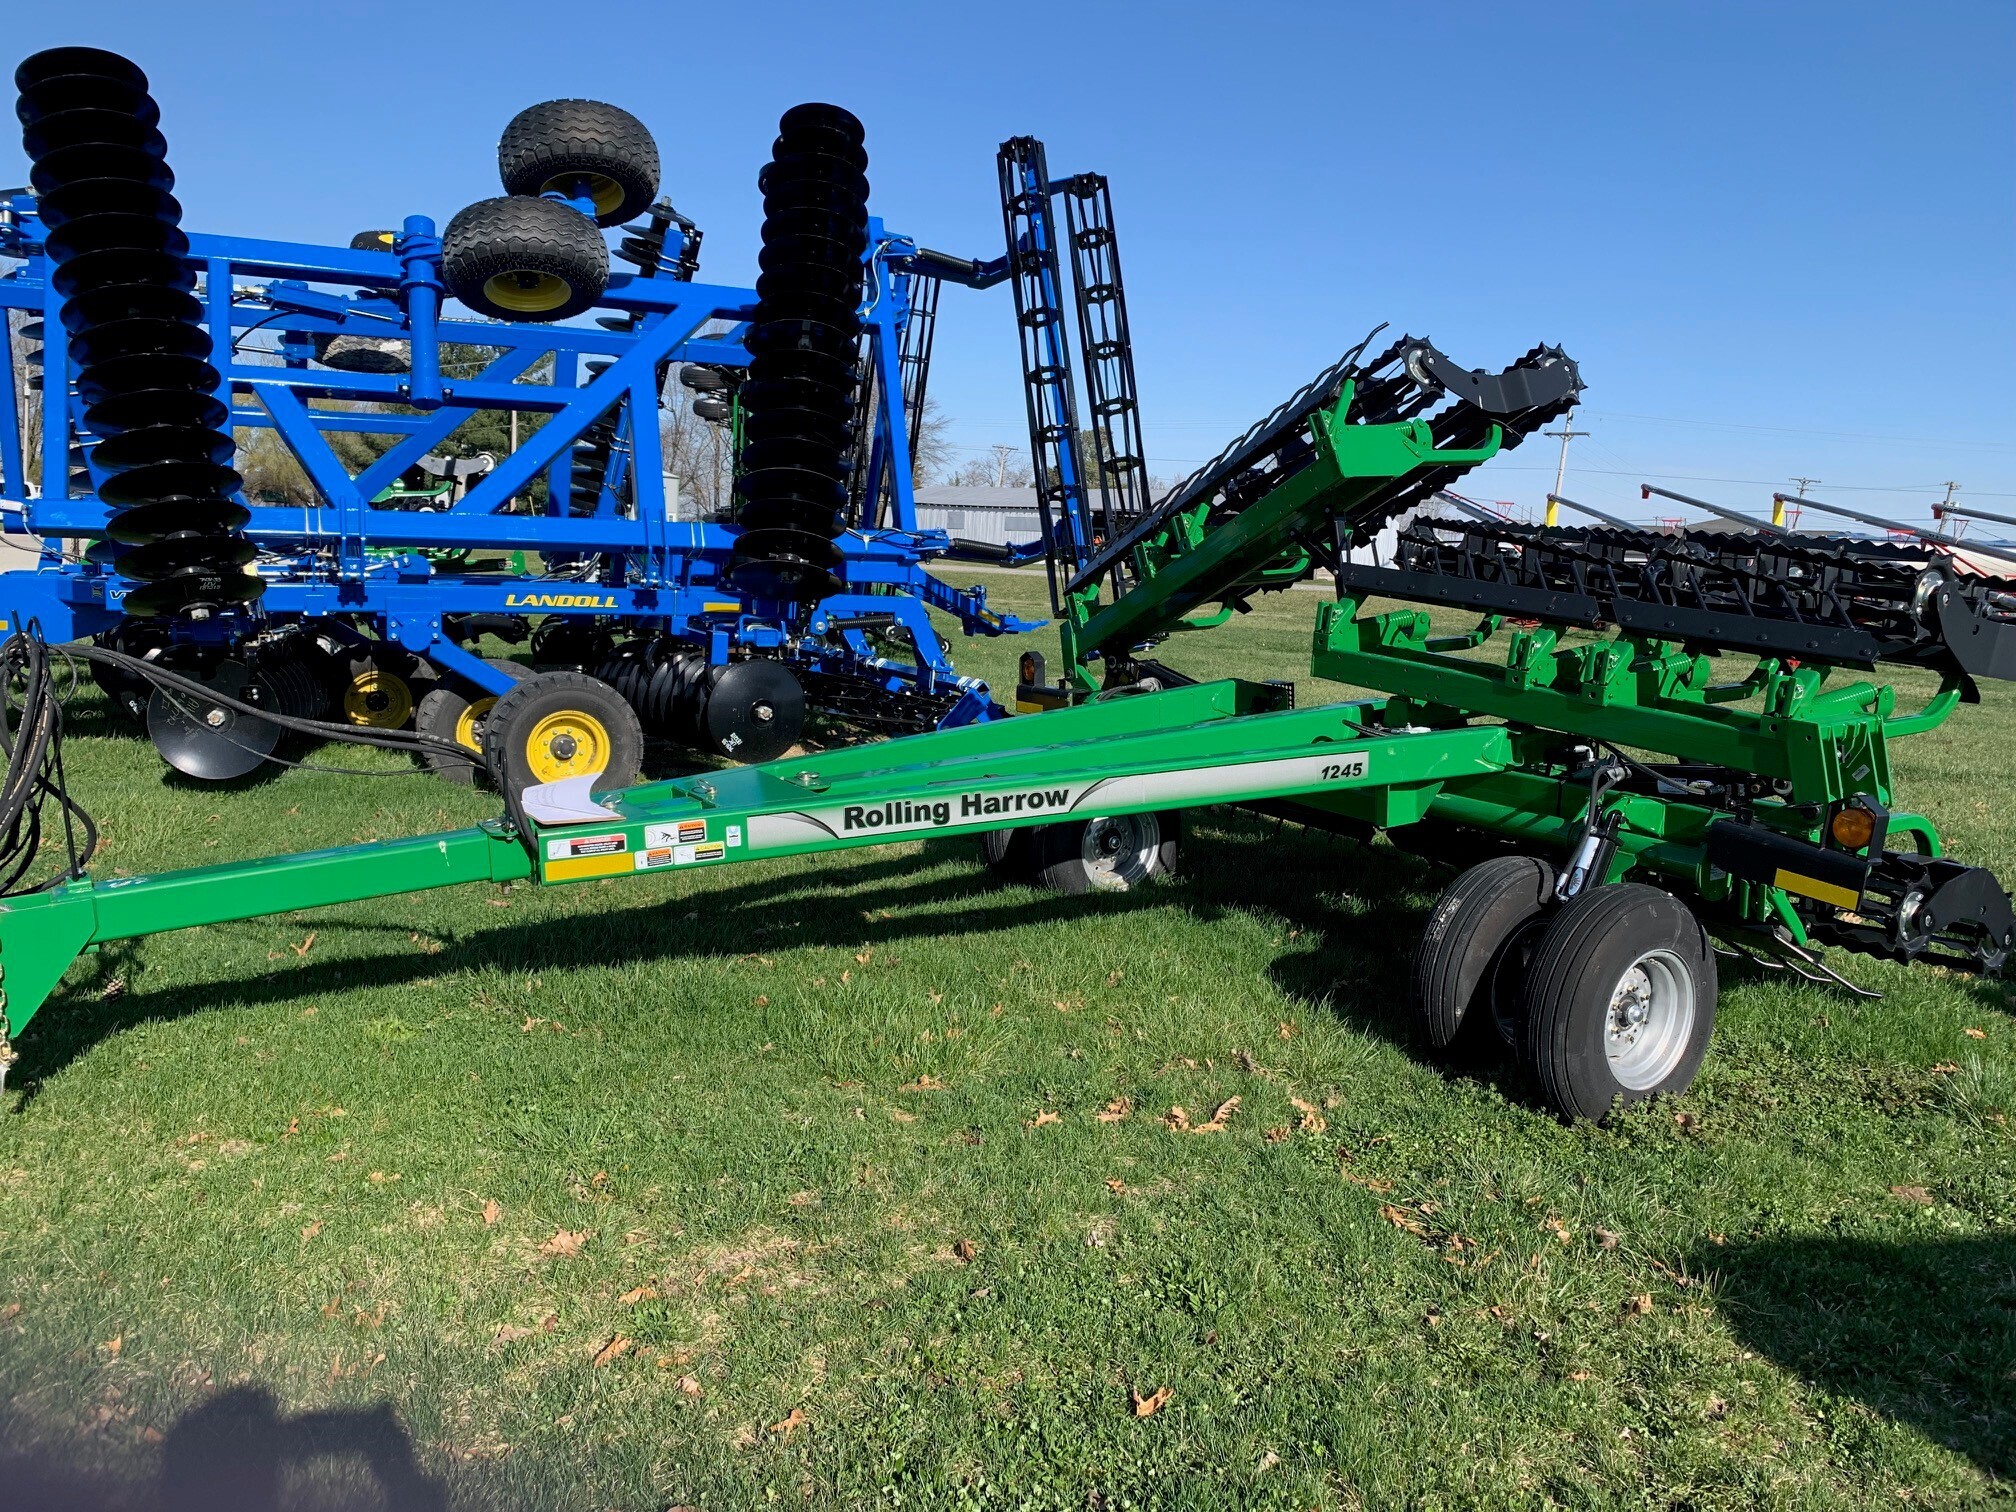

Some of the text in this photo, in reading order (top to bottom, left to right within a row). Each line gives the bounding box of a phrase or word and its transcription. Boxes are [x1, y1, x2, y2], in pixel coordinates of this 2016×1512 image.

[505, 594, 619, 608] LANDOLL
[1321, 762, 1363, 780] 1245
[843, 789, 1070, 831] Rolling Harrow
